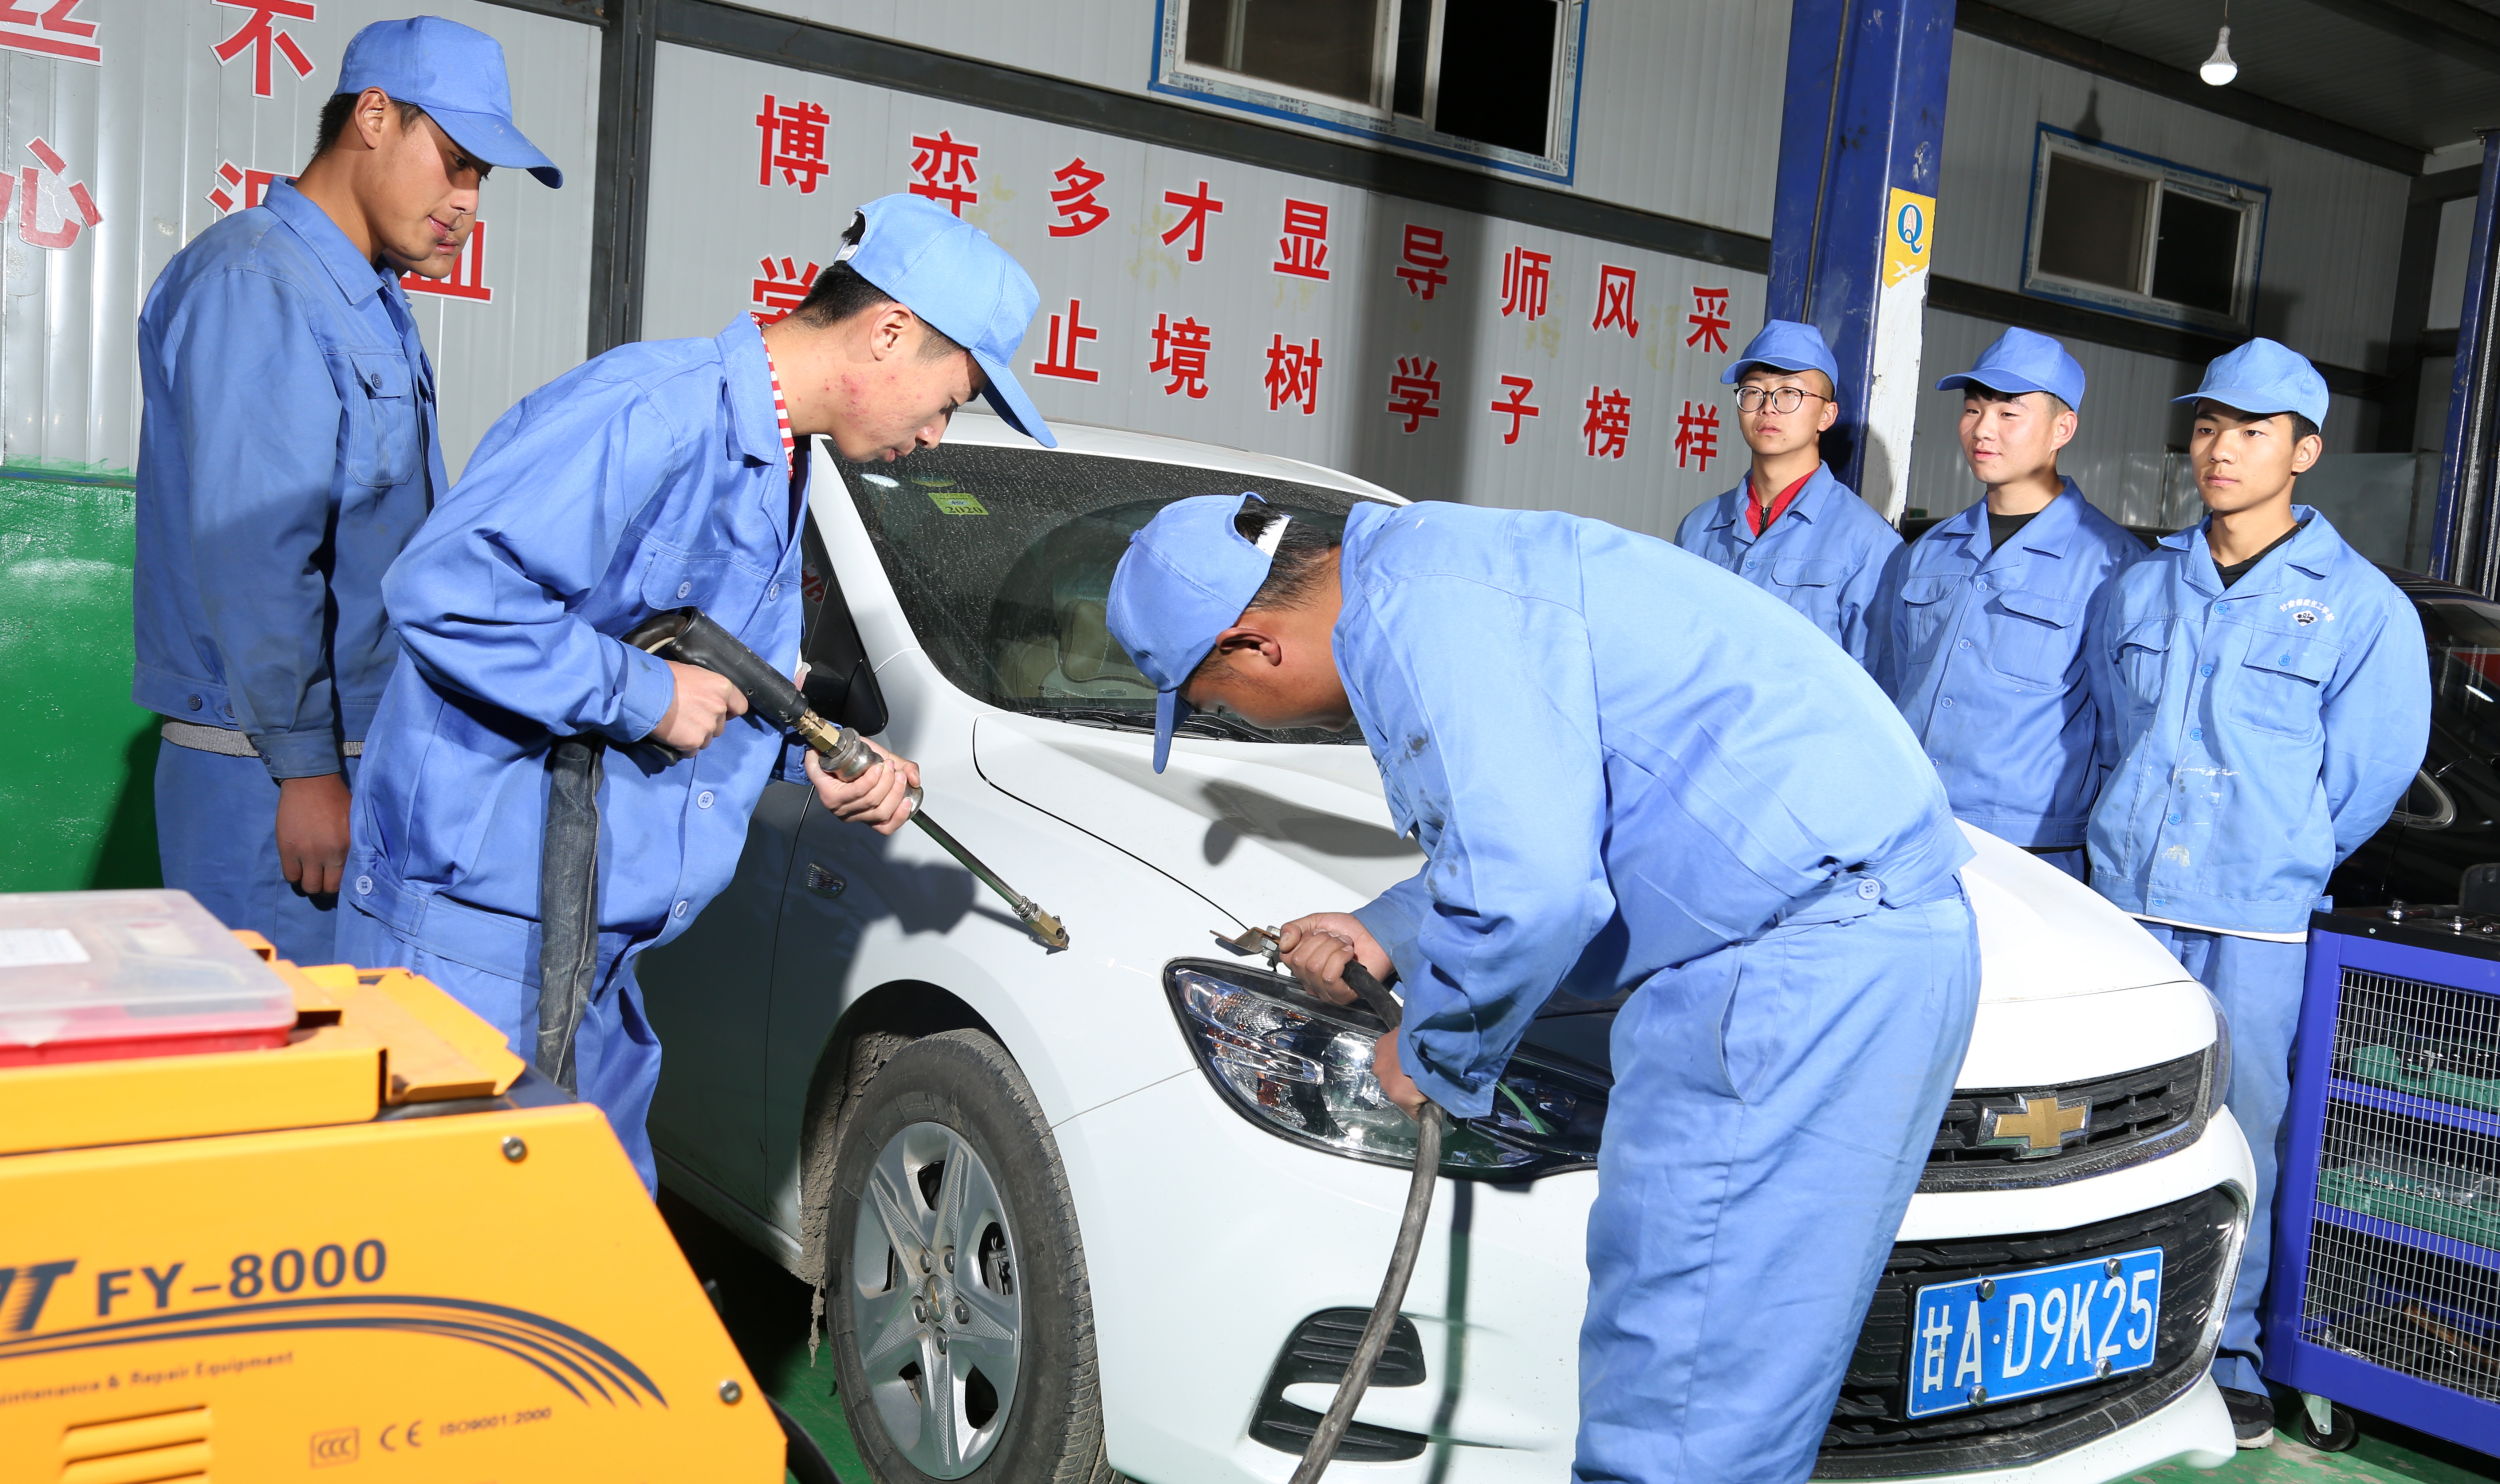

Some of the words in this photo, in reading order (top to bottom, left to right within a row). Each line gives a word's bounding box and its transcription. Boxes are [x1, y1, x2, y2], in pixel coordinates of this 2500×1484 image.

[750, 256, 1721, 470] 学止境树学子榜样
[945, 506, 983, 514] 2020
[97, 1239, 387, 1317] FY-8000
